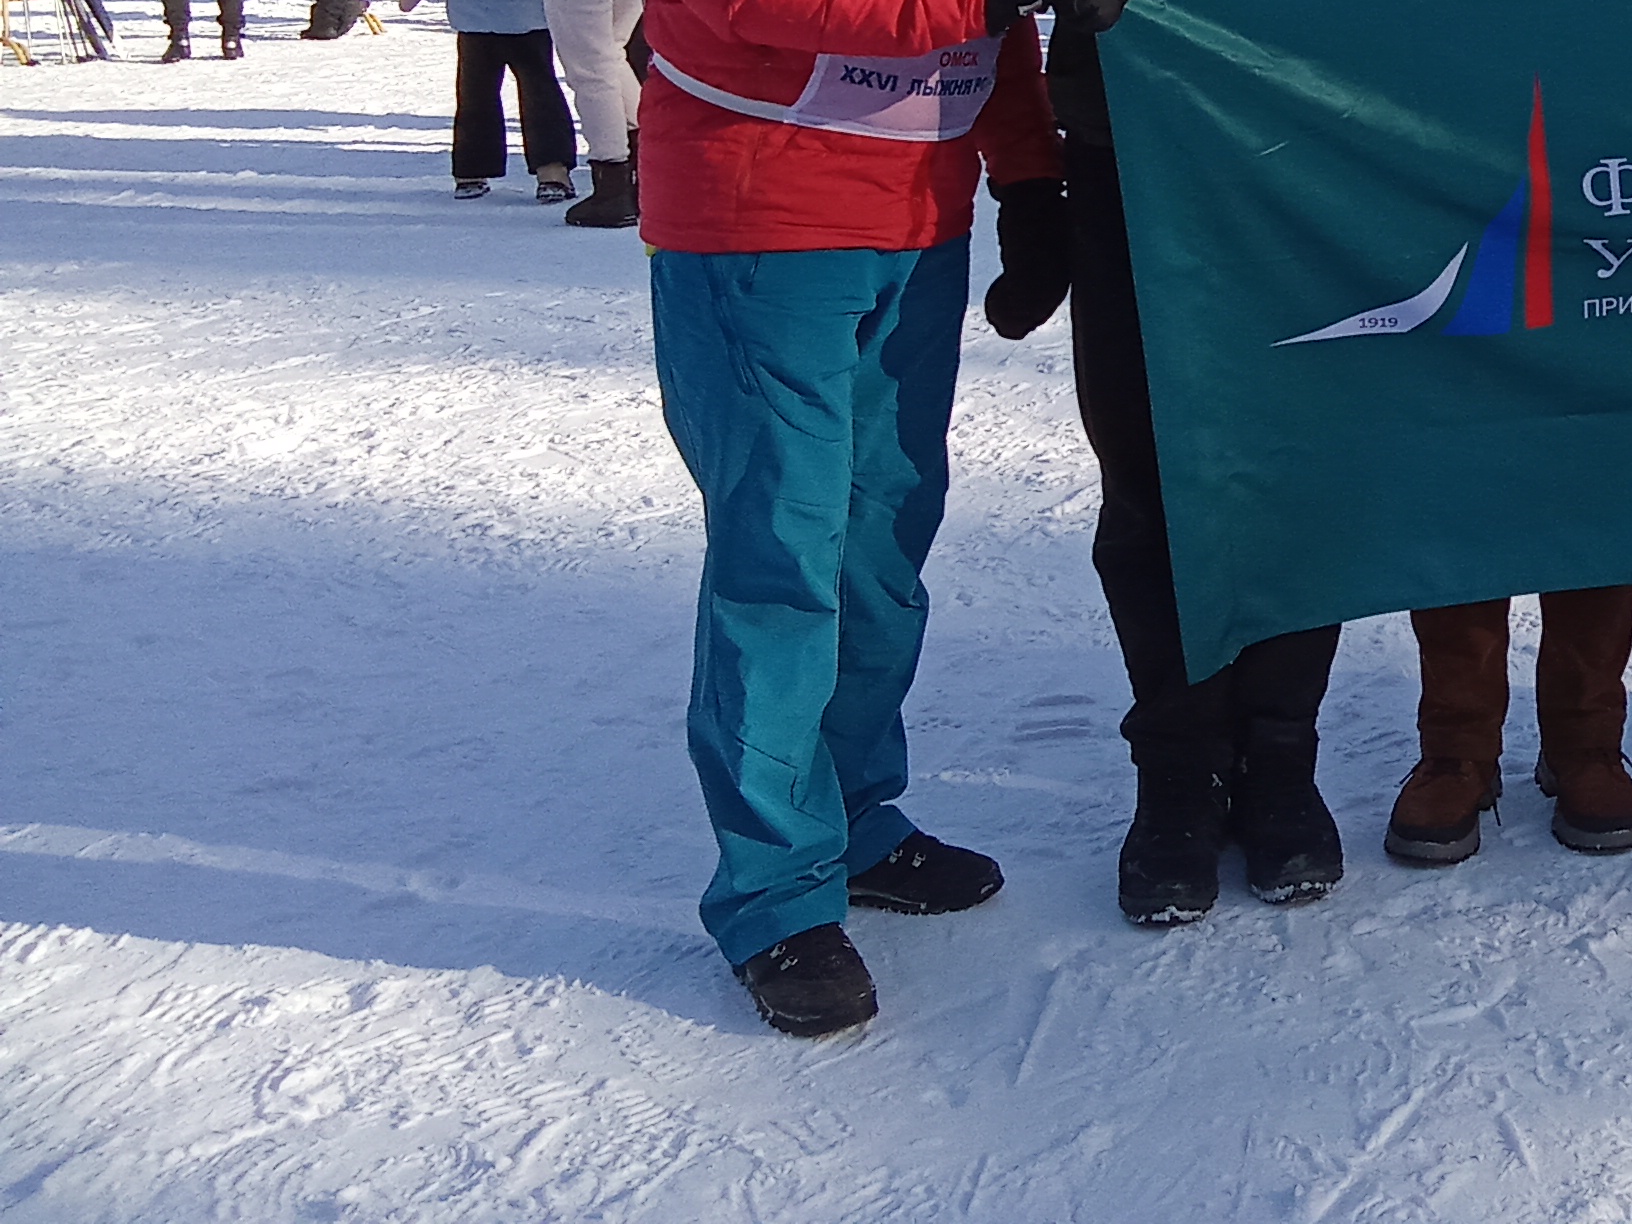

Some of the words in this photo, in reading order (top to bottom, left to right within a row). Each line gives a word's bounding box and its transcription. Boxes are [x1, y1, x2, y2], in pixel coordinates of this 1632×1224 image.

[939, 51, 979, 68] ОМСК
[839, 64, 899, 93] XXVI
[906, 76, 974, 97] ЛЫЖНЯ
[1358, 317, 1399, 329] 1919
